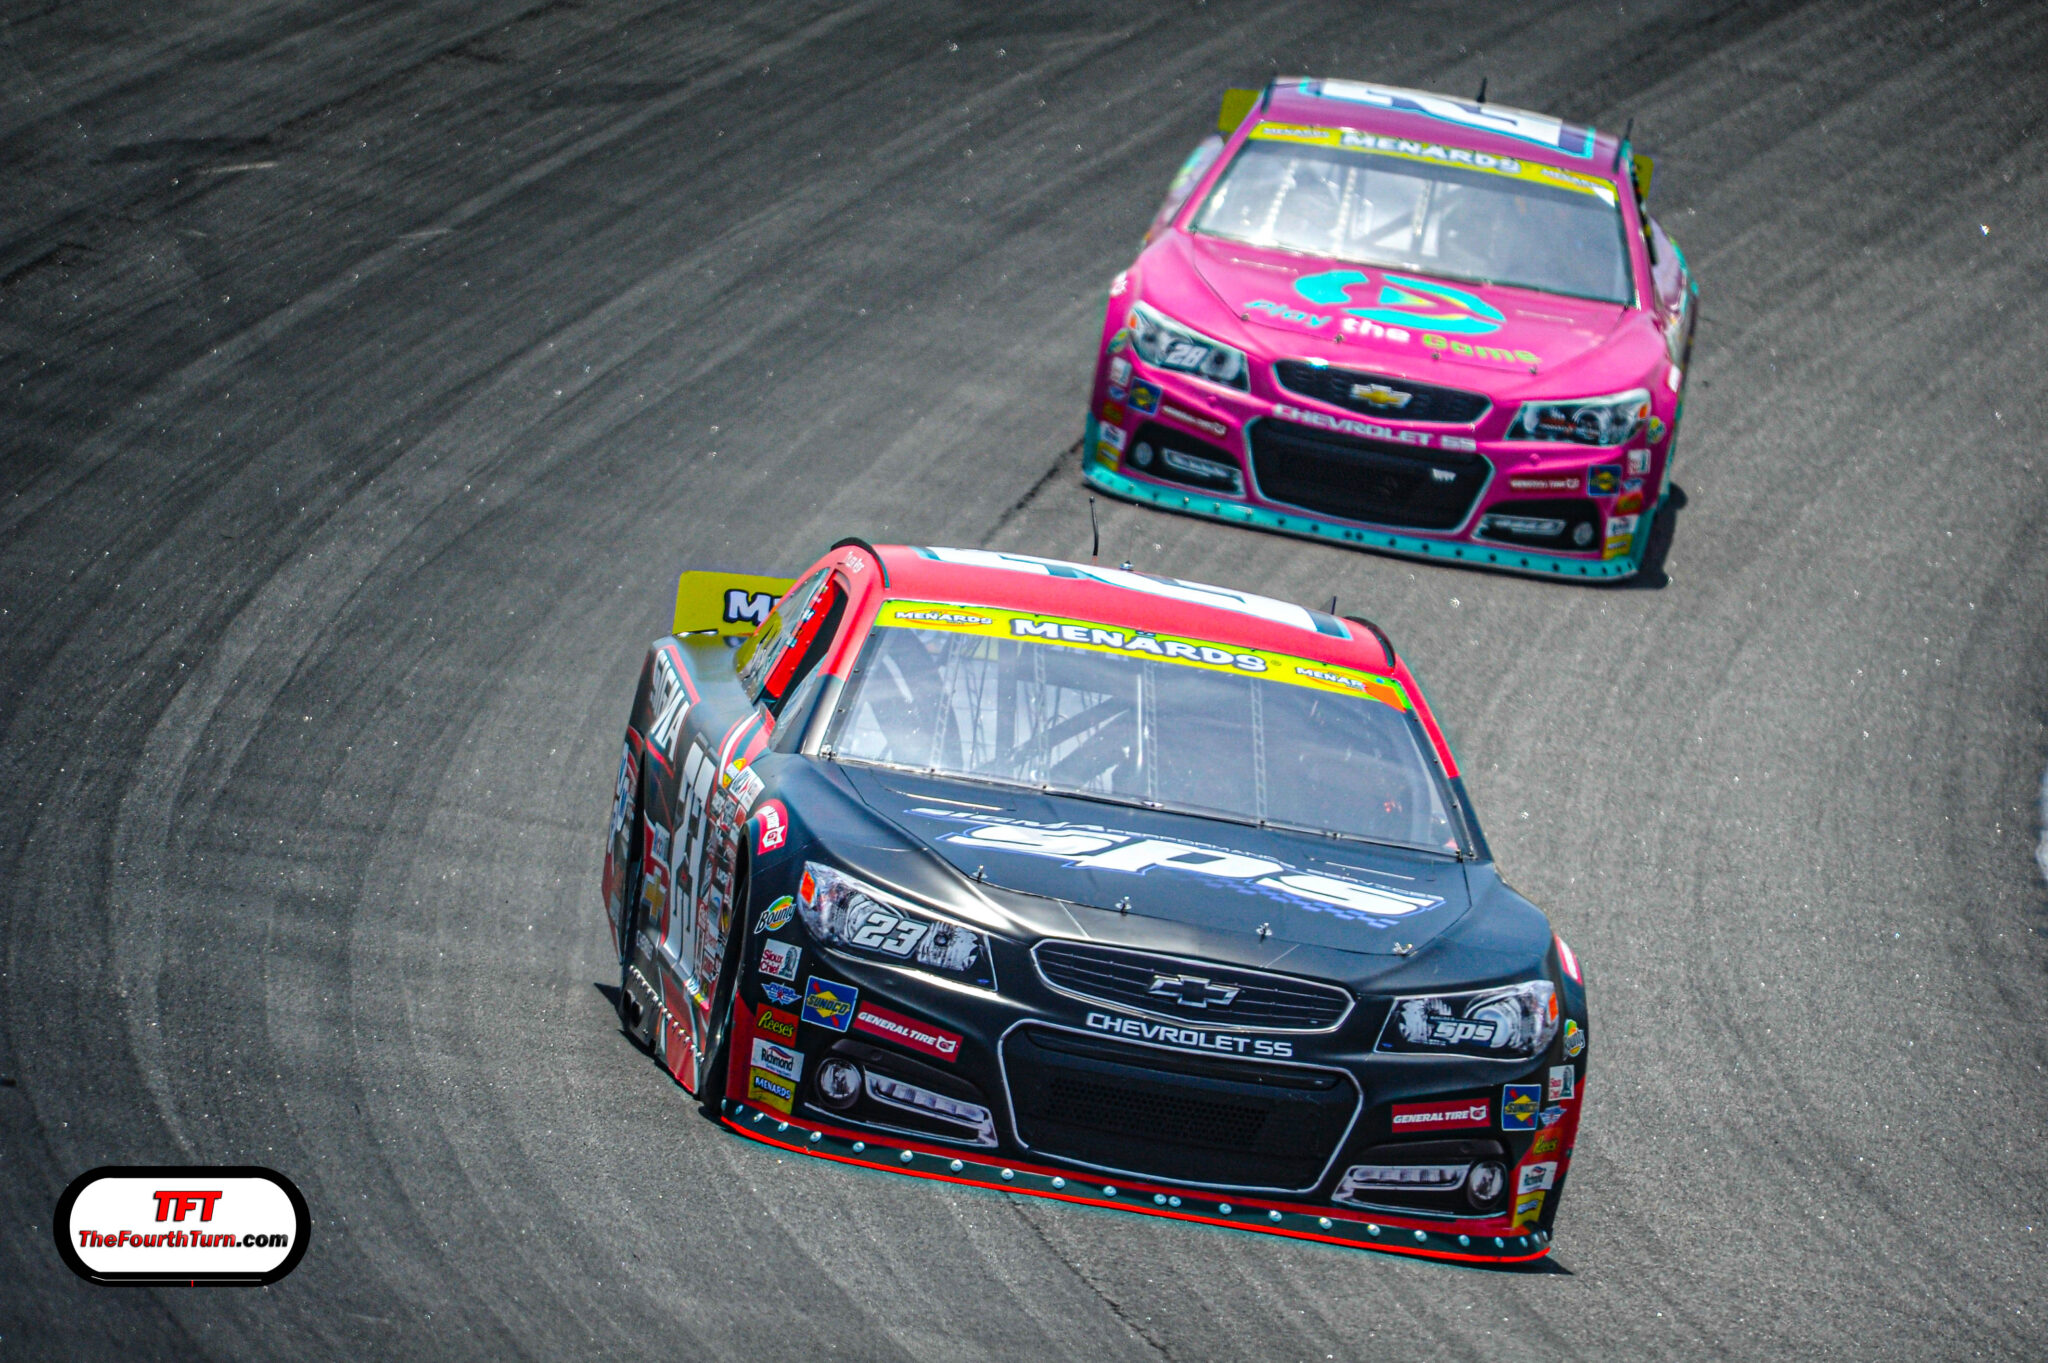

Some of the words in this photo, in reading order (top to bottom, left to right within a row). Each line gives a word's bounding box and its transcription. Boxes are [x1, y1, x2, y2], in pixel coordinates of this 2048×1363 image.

[1340, 131, 1522, 174] MENARDS
[1342, 317, 1411, 343] the
[1273, 403, 1434, 446] CHEVROLET
[723, 589, 783, 627] M
[894, 611, 993, 625] MENARDS
[1009, 617, 1269, 674] MENARDS
[1295, 667, 1365, 690] MENAR
[851, 911, 929, 958] 23
[805, 994, 851, 1016] SUNOCO
[757, 1010, 795, 1037] Reese's
[858, 1011, 909, 1036] GENERAL
[909, 1030, 937, 1045] TIRE
[1085, 1012, 1250, 1052] CHEVROLET
[1254, 1040, 1293, 1057] SS
[761, 1047, 793, 1071] Richmond
[754, 1076, 792, 1099] MENARDS
[1393, 1112, 1443, 1124] GENERAL
[1444, 1110, 1469, 1121] TIRE
